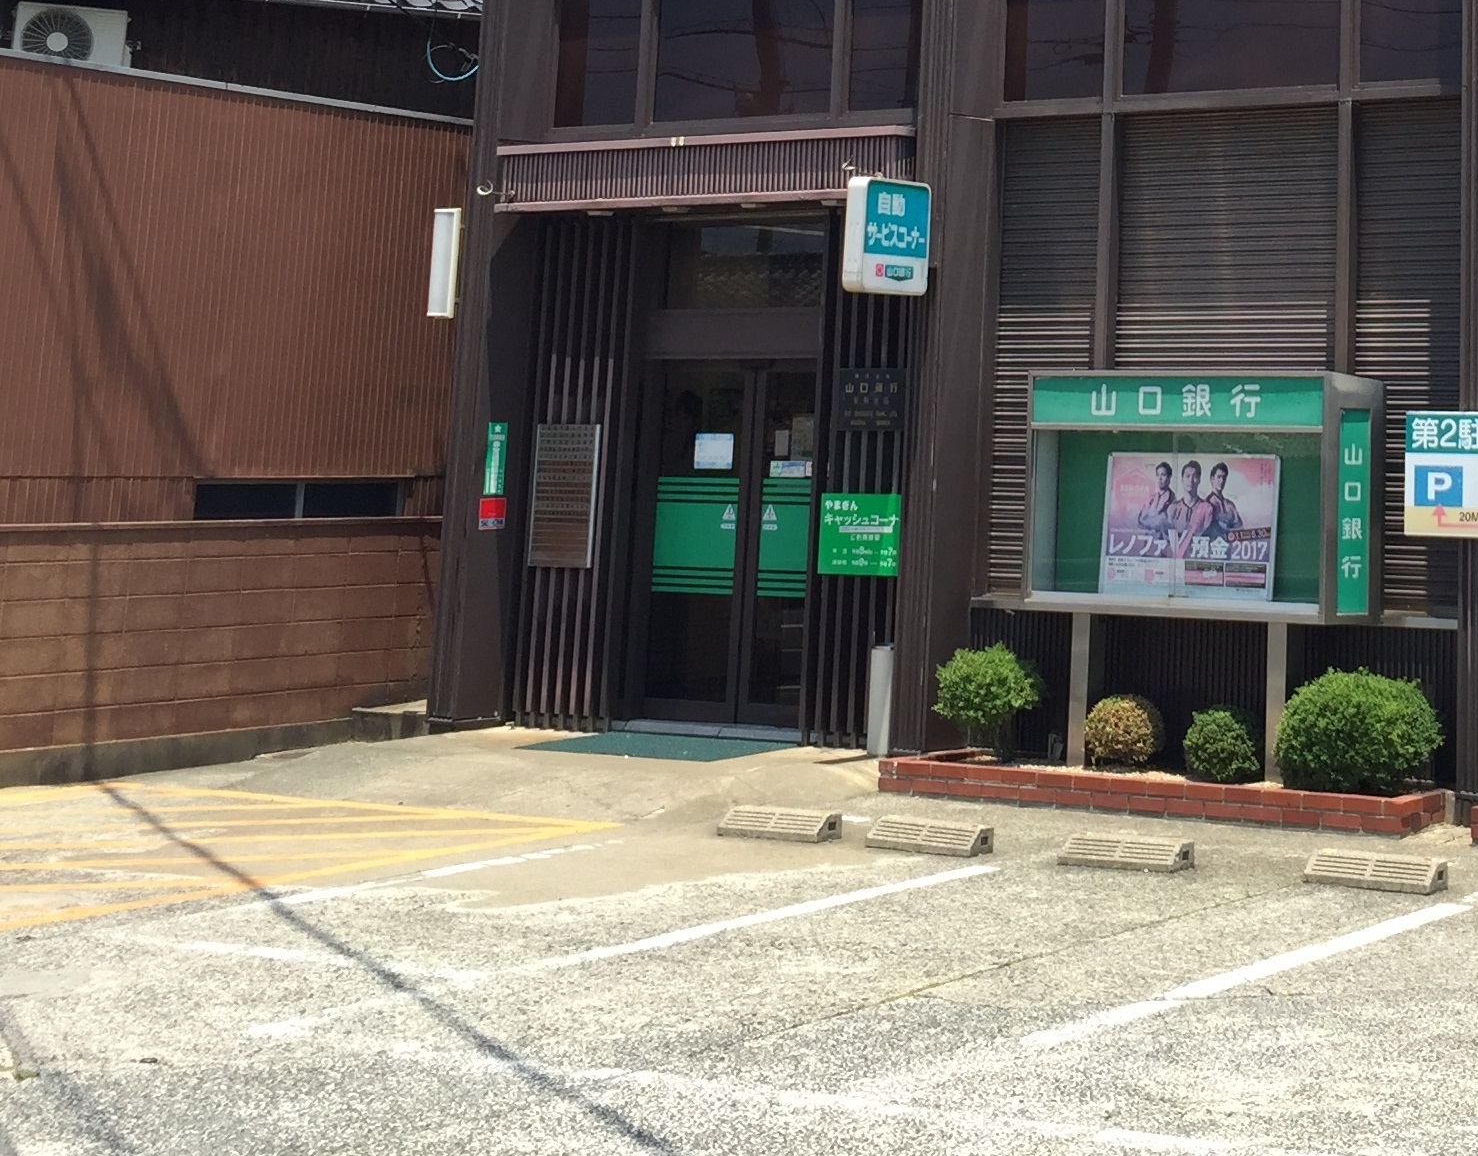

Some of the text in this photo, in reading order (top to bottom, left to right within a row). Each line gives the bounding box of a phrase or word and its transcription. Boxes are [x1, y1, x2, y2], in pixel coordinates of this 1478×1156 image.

[877, 191, 906, 217] 自動
[867, 221, 925, 250] サービスコーナー
[1090, 383, 1262, 419] 山口銀行
[1427, 471, 1453, 501] P
[824, 499, 859, 512] やまぎん
[1341, 443, 1364, 580] 山口銀行
